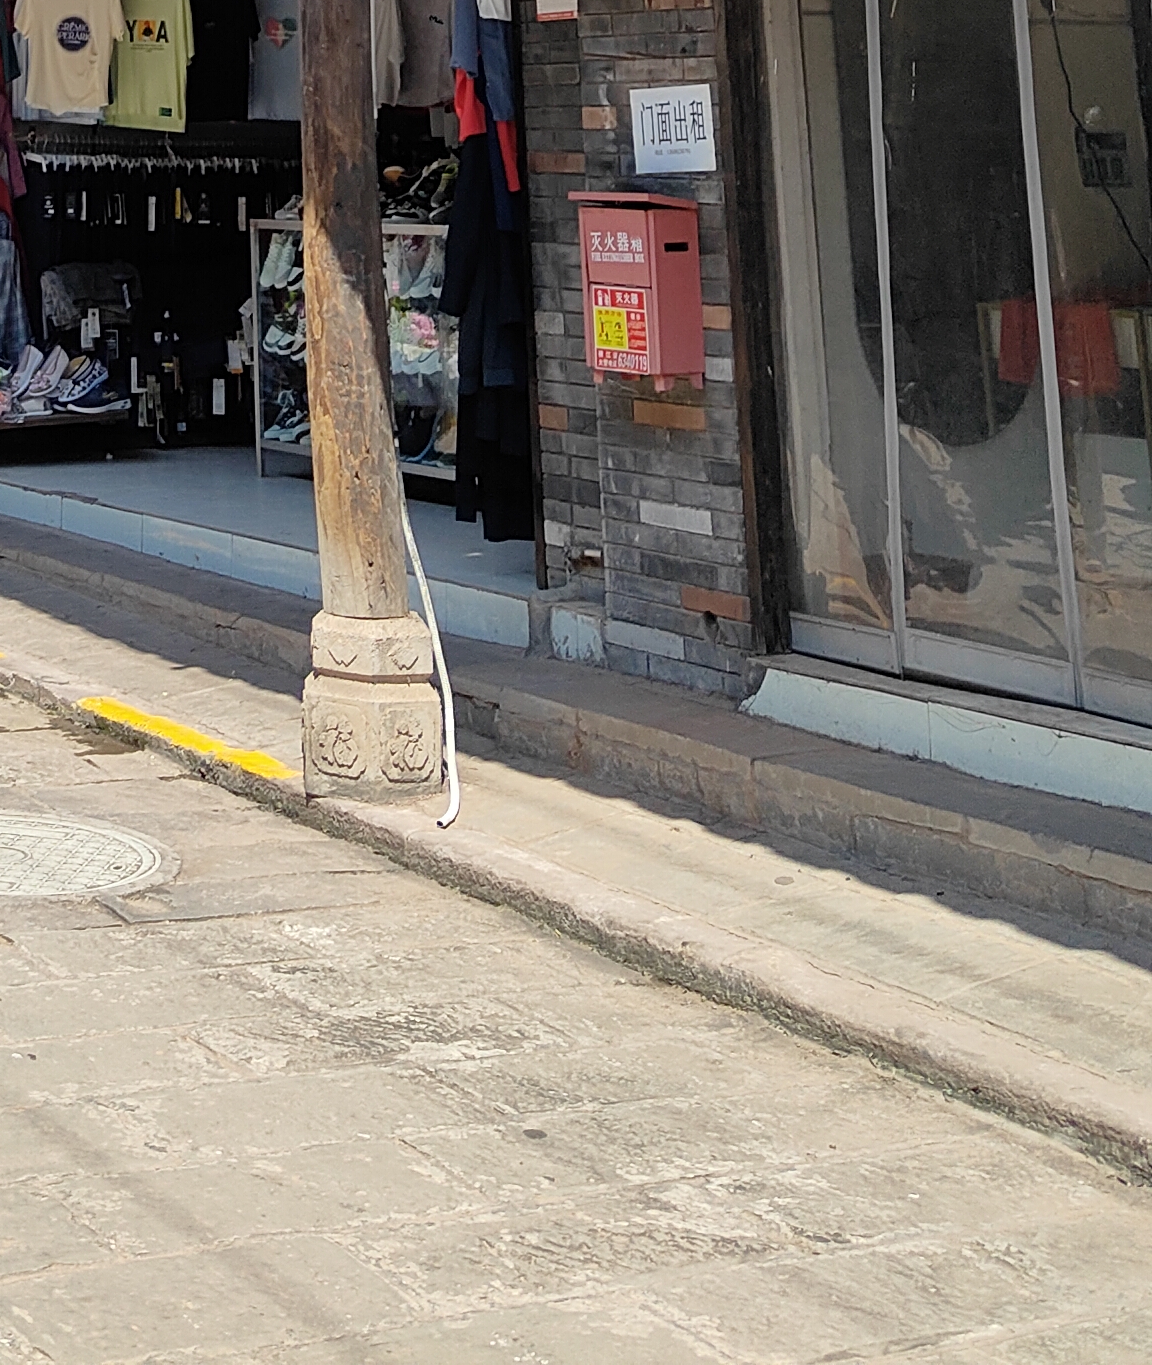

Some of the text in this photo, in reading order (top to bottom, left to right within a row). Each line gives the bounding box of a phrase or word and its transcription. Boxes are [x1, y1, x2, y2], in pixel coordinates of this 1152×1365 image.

[640, 99, 707, 146] 门面出租
[590, 231, 643, 252] 灭火器箱
[615, 292, 639, 305] 灭火器
